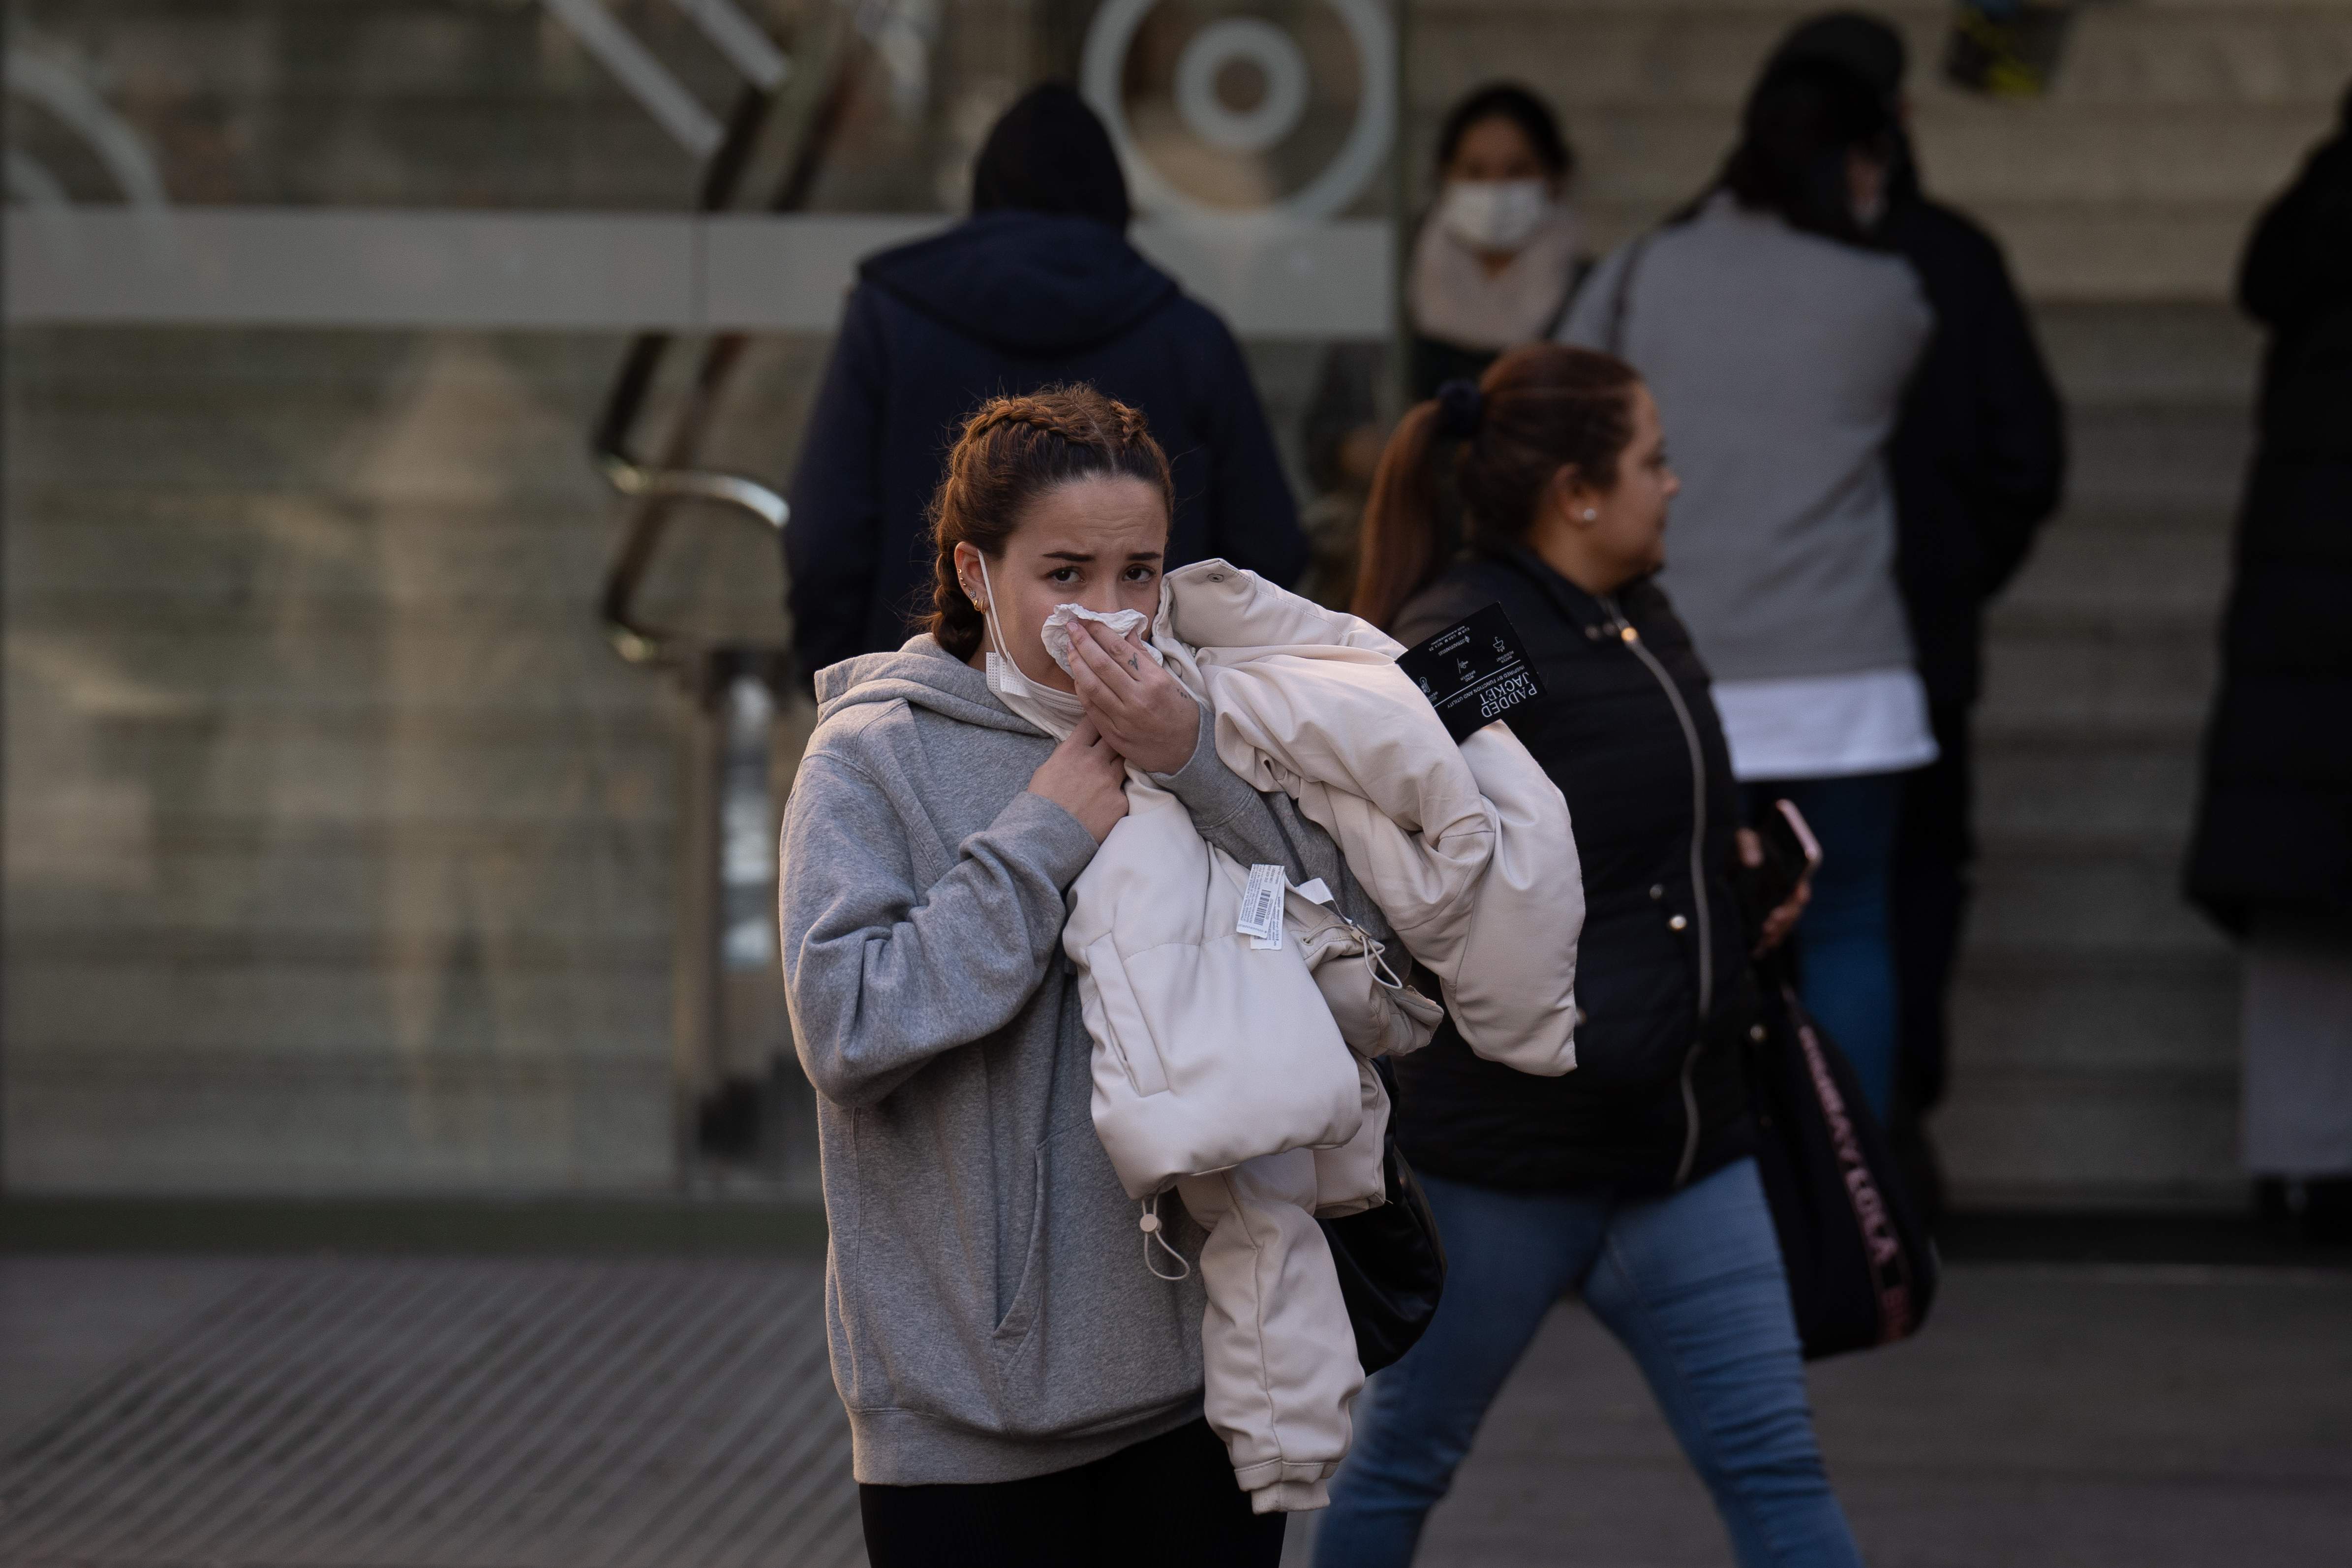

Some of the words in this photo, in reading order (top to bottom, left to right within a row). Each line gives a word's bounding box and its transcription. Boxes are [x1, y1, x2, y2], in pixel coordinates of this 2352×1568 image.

[1438, 639, 1466, 656] STRADIVARIUS
[1497, 651, 1514, 661] RESISTANT
[1501, 655, 1512, 663] WATER
[1461, 670, 1476, 680] BREAKER
[1503, 665, 1525, 677] INSPIRED
[1473, 679, 1496, 693] FUNCTION
[1480, 672, 1529, 706] JACKET
[1448, 697, 1463, 708] UTILITY
[1482, 683, 1537, 717] PADDED
